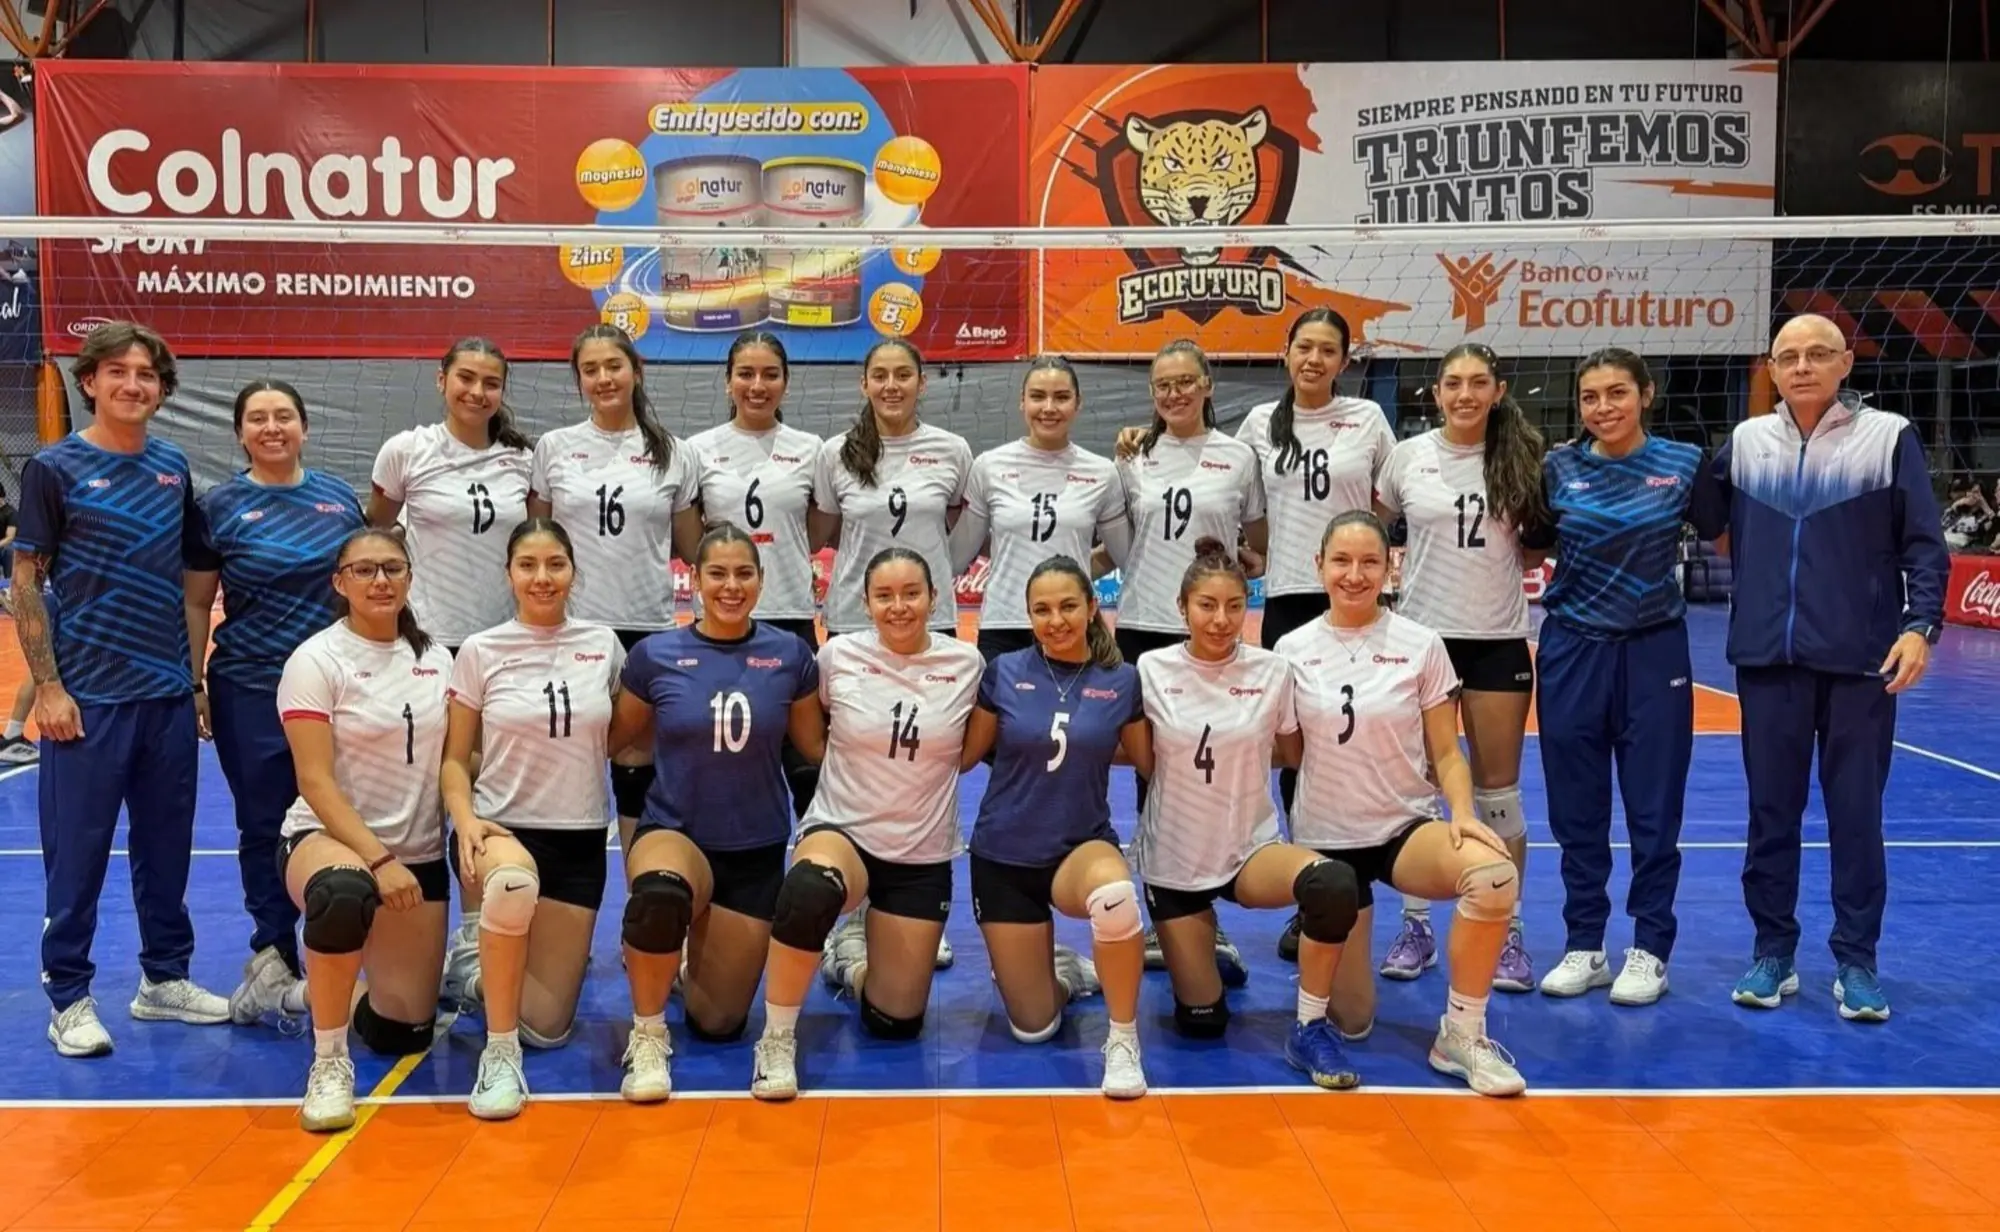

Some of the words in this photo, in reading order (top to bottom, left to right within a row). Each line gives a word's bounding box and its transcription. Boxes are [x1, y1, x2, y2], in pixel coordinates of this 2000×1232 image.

[654, 104, 803, 135] Enriquecido
[809, 108, 863, 131] con:
[1357, 97, 1455, 127] SIEMPRE
[1460, 86, 1579, 114] PENSANDO
[1585, 84, 1614, 104] EN
[1620, 84, 1650, 103] TU
[1655, 84, 1744, 104] FUTURO
[87, 127, 516, 221] Colnatur
[1354, 111, 1750, 185] TRIUNFEMOS
[1356, 170, 1591, 223] JUNTOS
[137, 265, 267, 296] MÁXIMO
[276, 274, 476, 299] RENDIMIENTO
[570, 246, 614, 268] Zinc
[1521, 261, 1603, 285] Banco
[1122, 266, 1283, 320] ECOFUTURO
[1520, 288, 1735, 329] Ecofuturo
[972, 325, 1007, 340] Bagó
[1299, 448, 1330, 501] 18
[596, 484, 626, 536] 16
[745, 477, 764, 529] 6
[888, 487, 908, 537] 9
[1031, 492, 1058, 542] 15
[1162, 486, 1192, 541] 19
[1453, 493, 1486, 549] 12
[402, 703, 415, 764] 1
[543, 681, 571, 738] 11
[709, 691, 751, 753] 10
[887, 700, 920, 762] 14
[1338, 684, 1356, 745] 3
[1046, 712, 1070, 772] 5
[1193, 723, 1215, 784] 4
